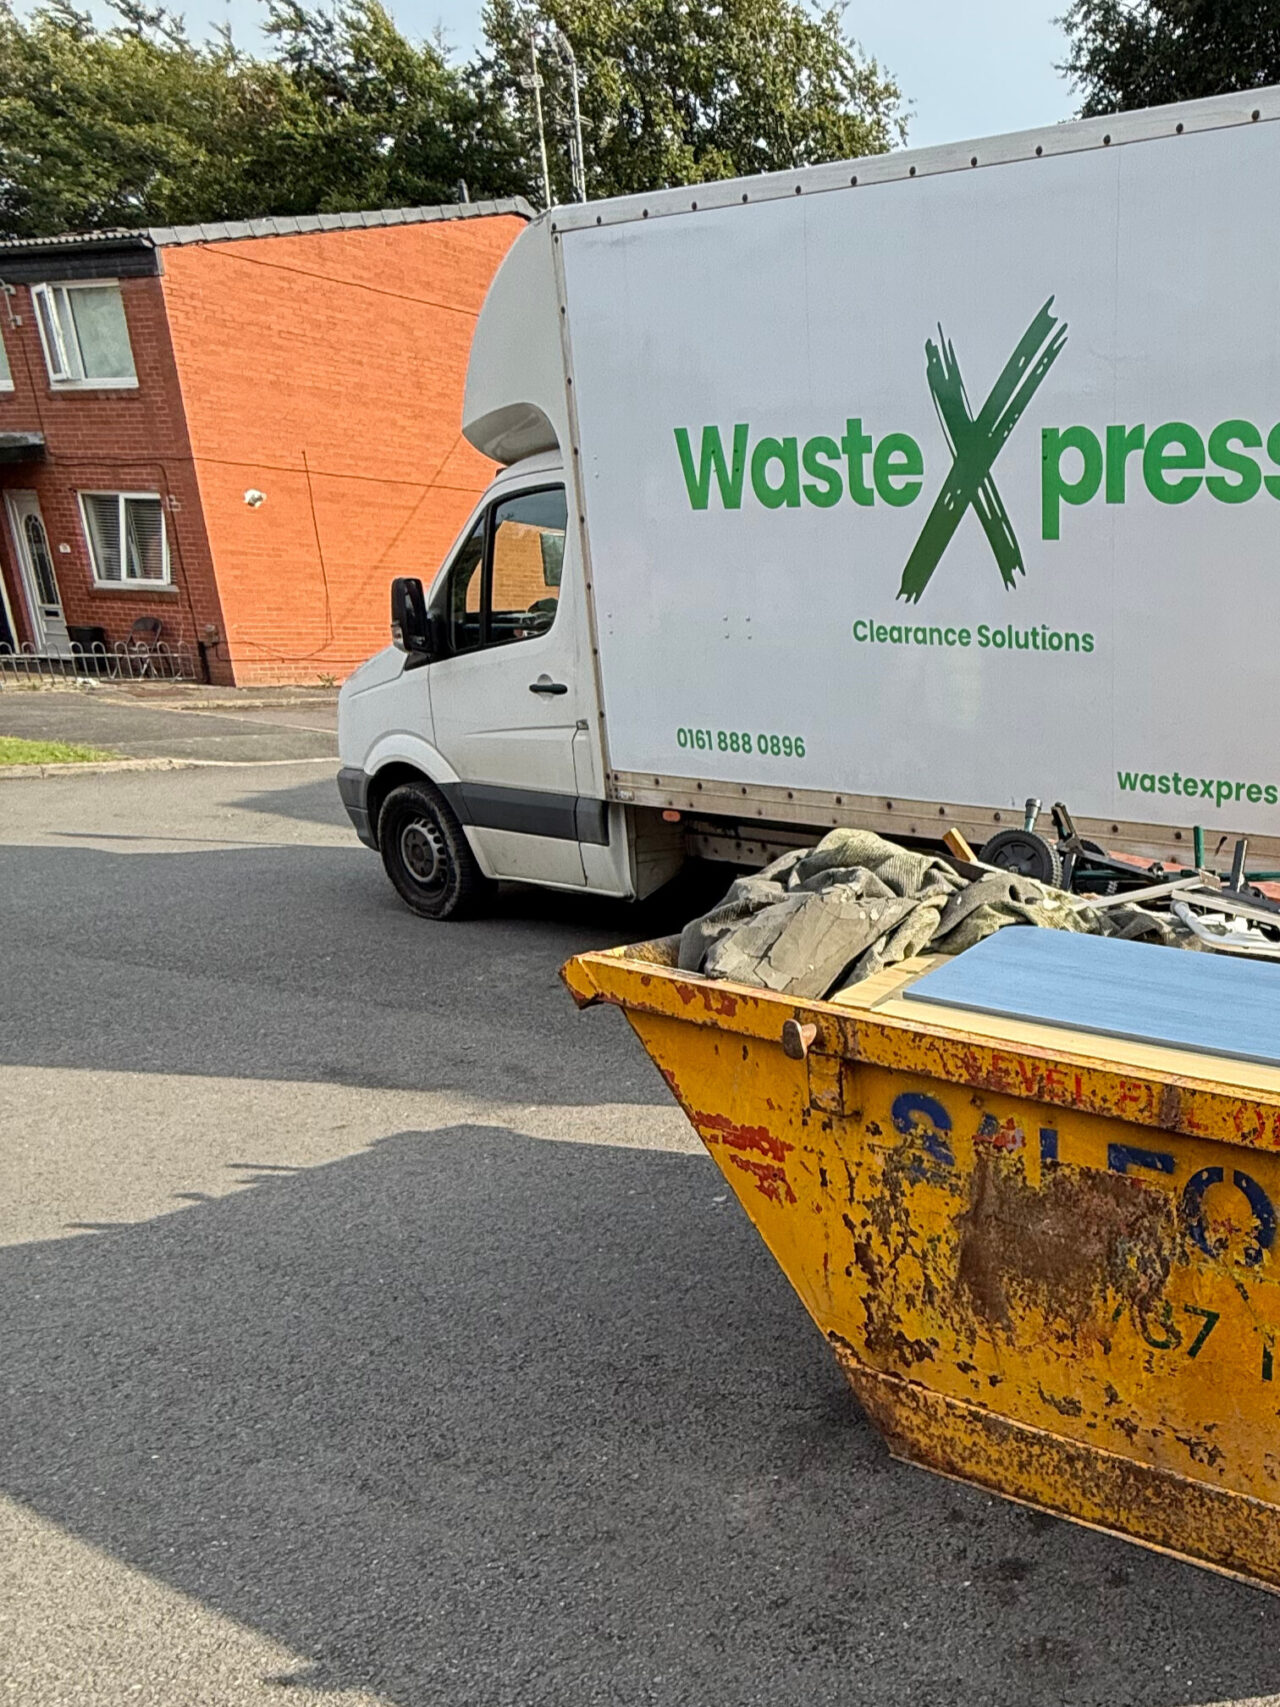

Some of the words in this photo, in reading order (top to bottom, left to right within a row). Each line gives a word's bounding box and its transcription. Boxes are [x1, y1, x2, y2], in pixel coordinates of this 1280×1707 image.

[852, 619, 972, 647] Clearance
[977, 624, 1095, 653] Solutions
[676, 727, 713, 750] 0161
[717, 730, 752, 754] 888
[757, 733, 806, 758] 0896
[1119, 1080, 1209, 1133] FIL
